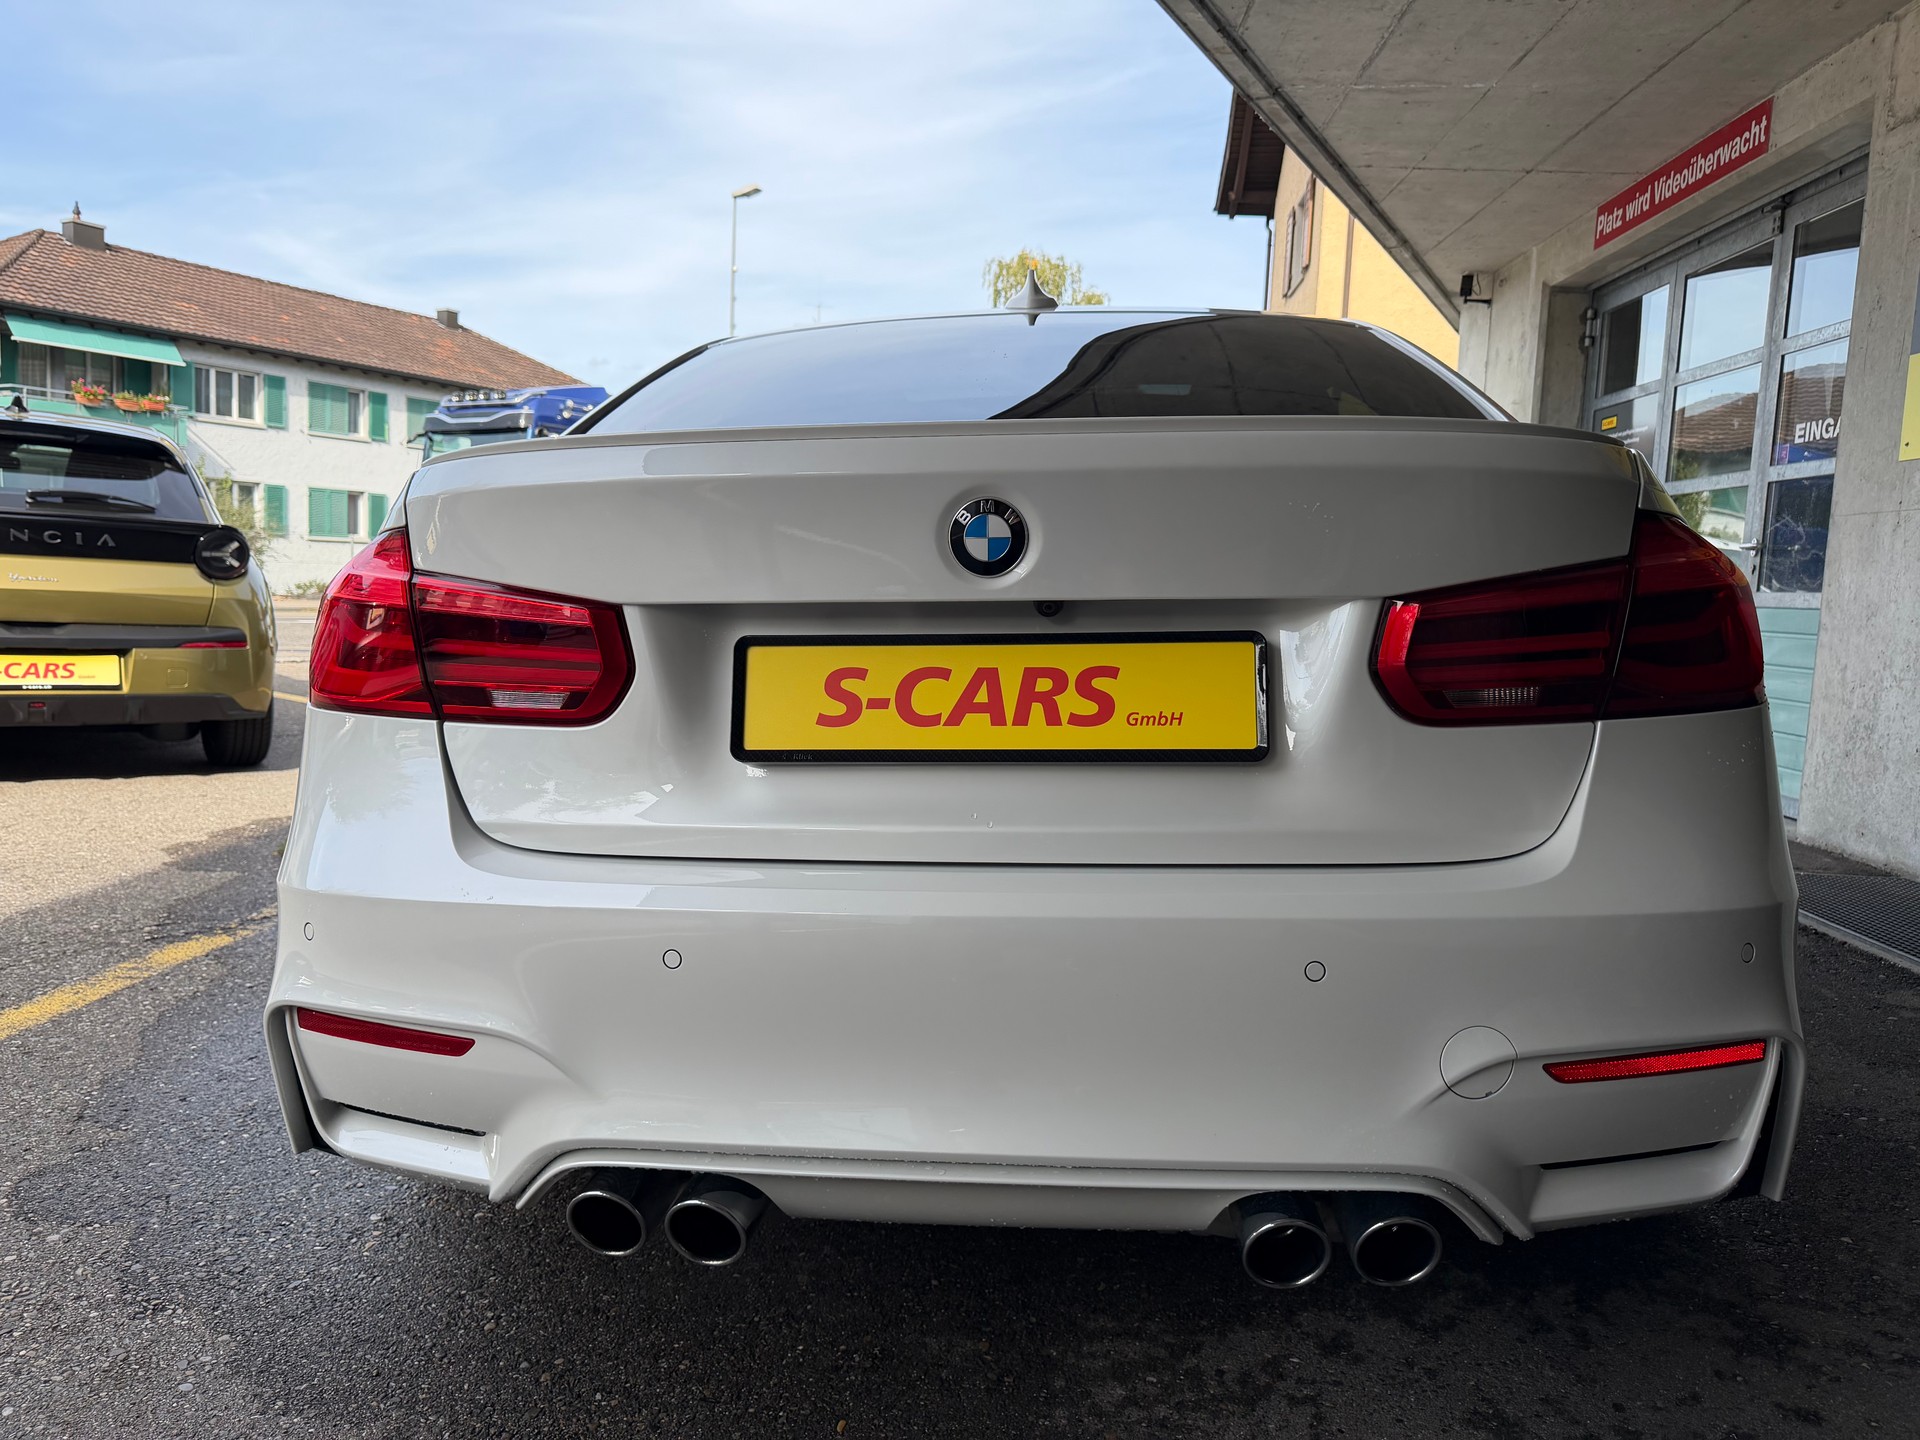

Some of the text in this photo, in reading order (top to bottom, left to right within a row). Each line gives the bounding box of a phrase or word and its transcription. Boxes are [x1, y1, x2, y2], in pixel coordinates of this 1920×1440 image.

[1596, 114, 1767, 239] Platz wird Videoüberwacht
[956, 500, 1020, 525] BMW
[815, 666, 1184, 728] S-CARS GmbH
